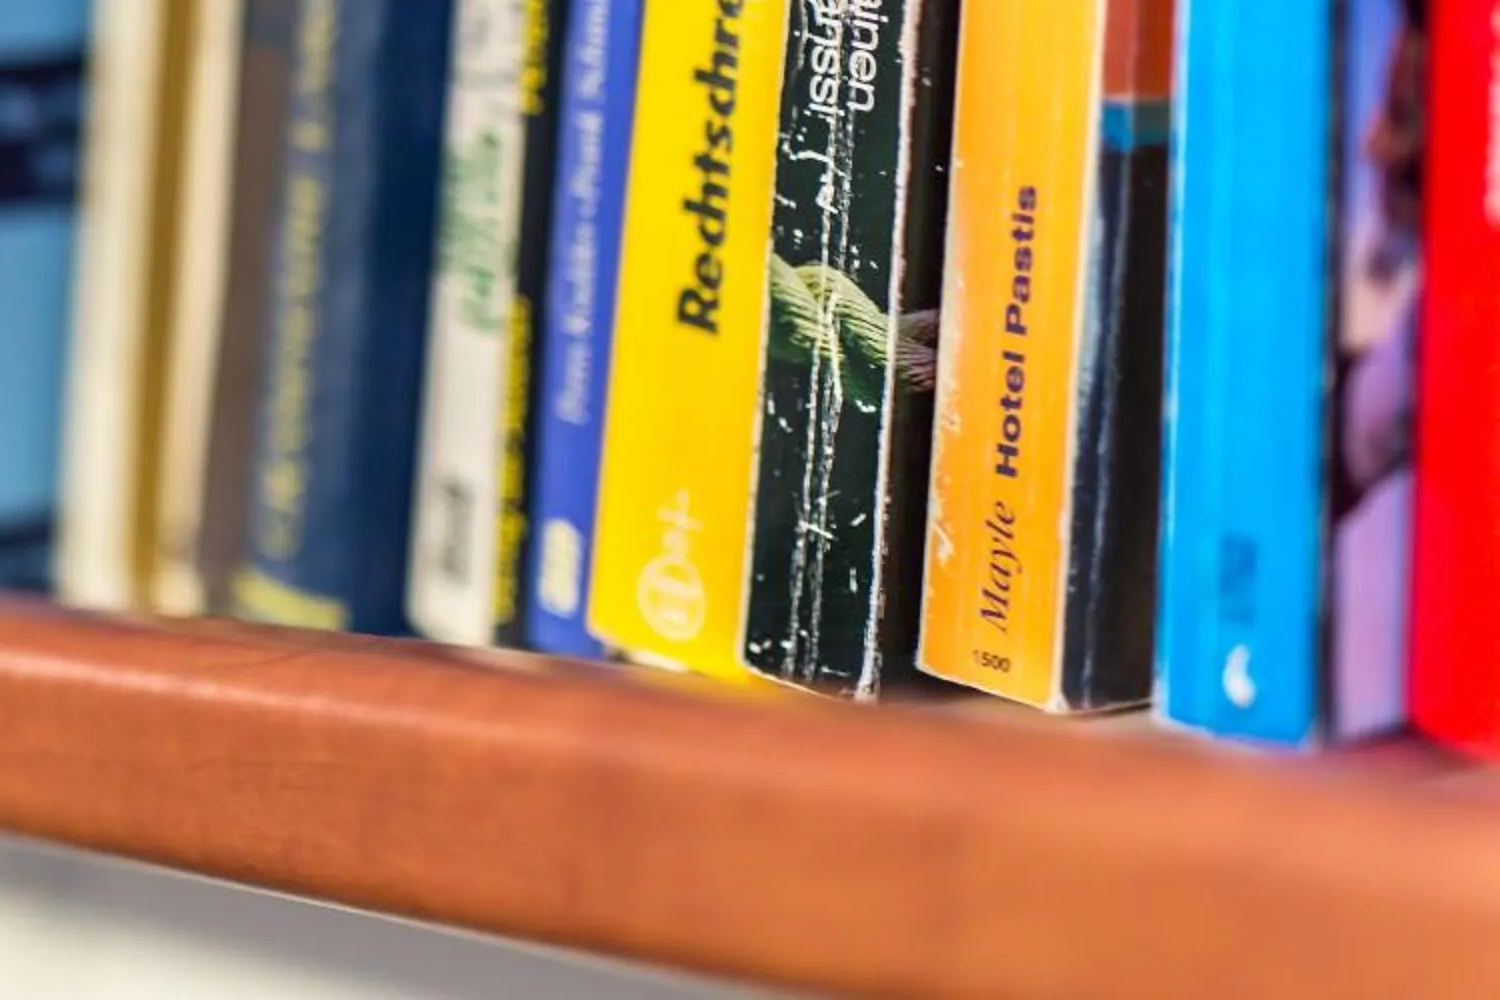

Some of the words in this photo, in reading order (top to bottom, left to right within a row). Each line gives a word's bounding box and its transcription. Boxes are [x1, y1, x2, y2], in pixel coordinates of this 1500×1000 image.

[1003, 185, 1038, 336] Pastis
[995, 351, 1026, 478] Hotel
[979, 502, 1024, 634] Mayle
[973, 648, 1011, 674] 1500
